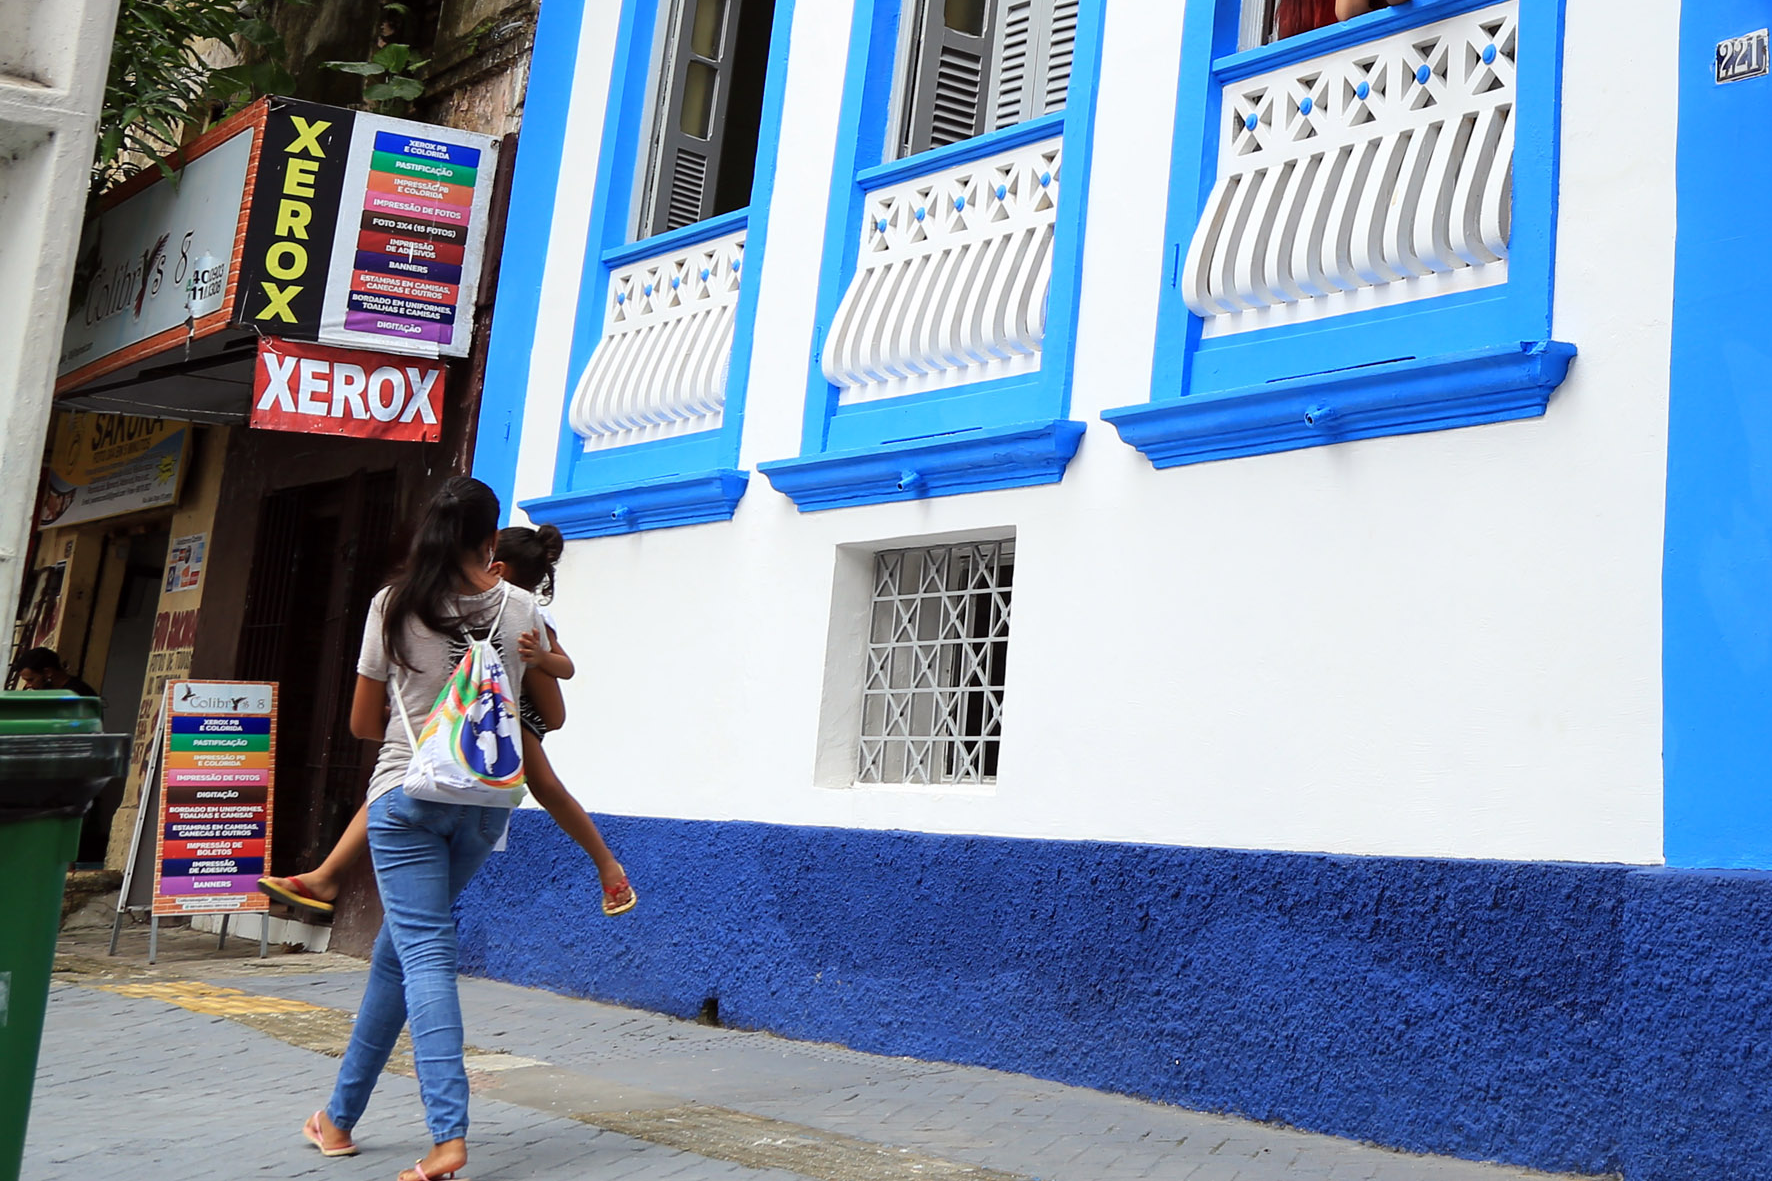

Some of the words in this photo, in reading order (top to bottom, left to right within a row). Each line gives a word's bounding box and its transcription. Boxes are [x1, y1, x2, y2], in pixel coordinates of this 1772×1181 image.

[1719, 35, 1760, 78] 221
[408, 139, 435, 151] XEROX
[436, 144, 448, 152] PB
[411, 147, 450, 161] COLORIDA
[395, 160, 454, 177] PASTIFICAÇÃO
[394, 178, 438, 192] IMPRESSÃO
[438, 186, 449, 194] PB
[403, 187, 444, 200] COLORIDA
[373, 198, 421, 213] IMPRESSÃO
[422, 206, 433, 214] DE
[434, 208, 462, 220] FOTOS
[254, 115, 333, 324] XEROX
[372, 217, 395, 228] FOTO
[396, 222, 413, 231] 3X4
[413, 223, 426, 234] (15
[426, 225, 457, 239] FOTOS)
[389, 238, 434, 251] IMPRESSÃO
[174, 229, 194, 285] 8
[385, 245, 396, 253] DE
[397, 247, 436, 259] ADESIVOS
[388, 261, 429, 274] BANNERS
[360, 274, 401, 287] ESTAMPAS
[401, 280, 414, 288] EM
[366, 282, 404, 294] CANECAS
[411, 289, 443, 299] OUTROS
[352, 293, 391, 305] BORDADO
[392, 299, 405, 307] EM
[362, 302, 399, 314] TOALHAS
[406, 309, 441, 320] CAMISAS
[376, 320, 422, 334] DIGITAÇÃO
[256, 352, 439, 424] XEROX
[256, 698, 266, 709] 8
[193, 738, 248, 747] PASTIFICAÇÃO
[176, 773, 222, 782] IMPRESSÃO
[223, 774, 233, 782] DE
[196, 789, 239, 799] DIGITAÇÃO
[186, 841, 231, 850] IMPRESSÃO
[232, 841, 243, 849] DE
[192, 859, 236, 868] IMPRESSÃO
[200, 866, 238, 874] ADESIVOS
[193, 880, 232, 888] BANNERS
